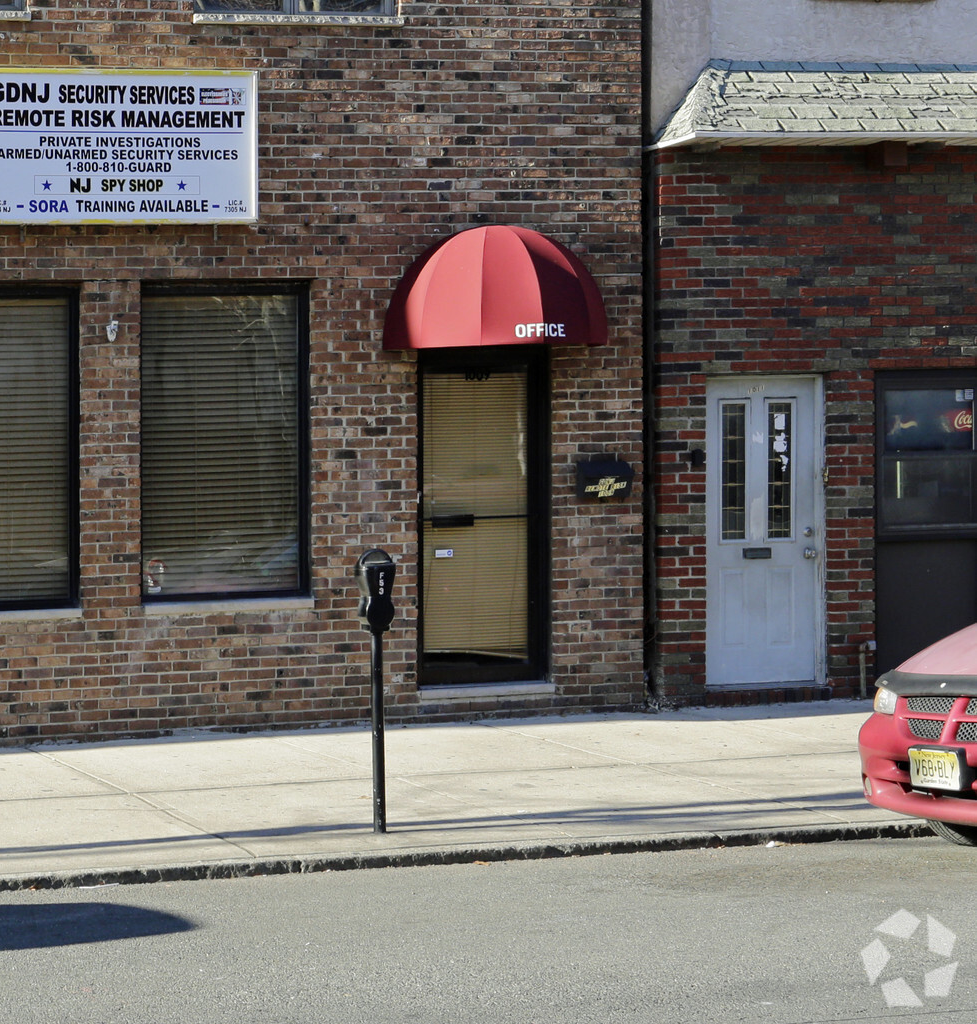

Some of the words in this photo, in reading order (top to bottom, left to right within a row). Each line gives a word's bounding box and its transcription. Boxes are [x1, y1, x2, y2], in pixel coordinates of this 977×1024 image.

[58, 84, 127, 104] SECURITY
[129, 85, 195, 105] SERVICES
[71, 110, 116, 127] RISK
[121, 110, 245, 128] MANAGEMENT
[39, 136, 92, 147] PRIVATE
[96, 137, 201, 148] INVESTIGATIONS
[111, 149, 174, 160] SECURITY
[177, 149, 238, 161] SERVICES
[66, 161, 172, 173] 1-800-810-GUARD
[69, 177, 91, 194] NJ
[101, 178, 126, 192] SPY
[129, 178, 164, 192] SHOP
[29, 199, 69, 213] SORA
[75, 199, 136, 213] TRAINING
[139, 199, 209, 213] AVAILABLE
[514, 322, 567, 338] OFFICE
